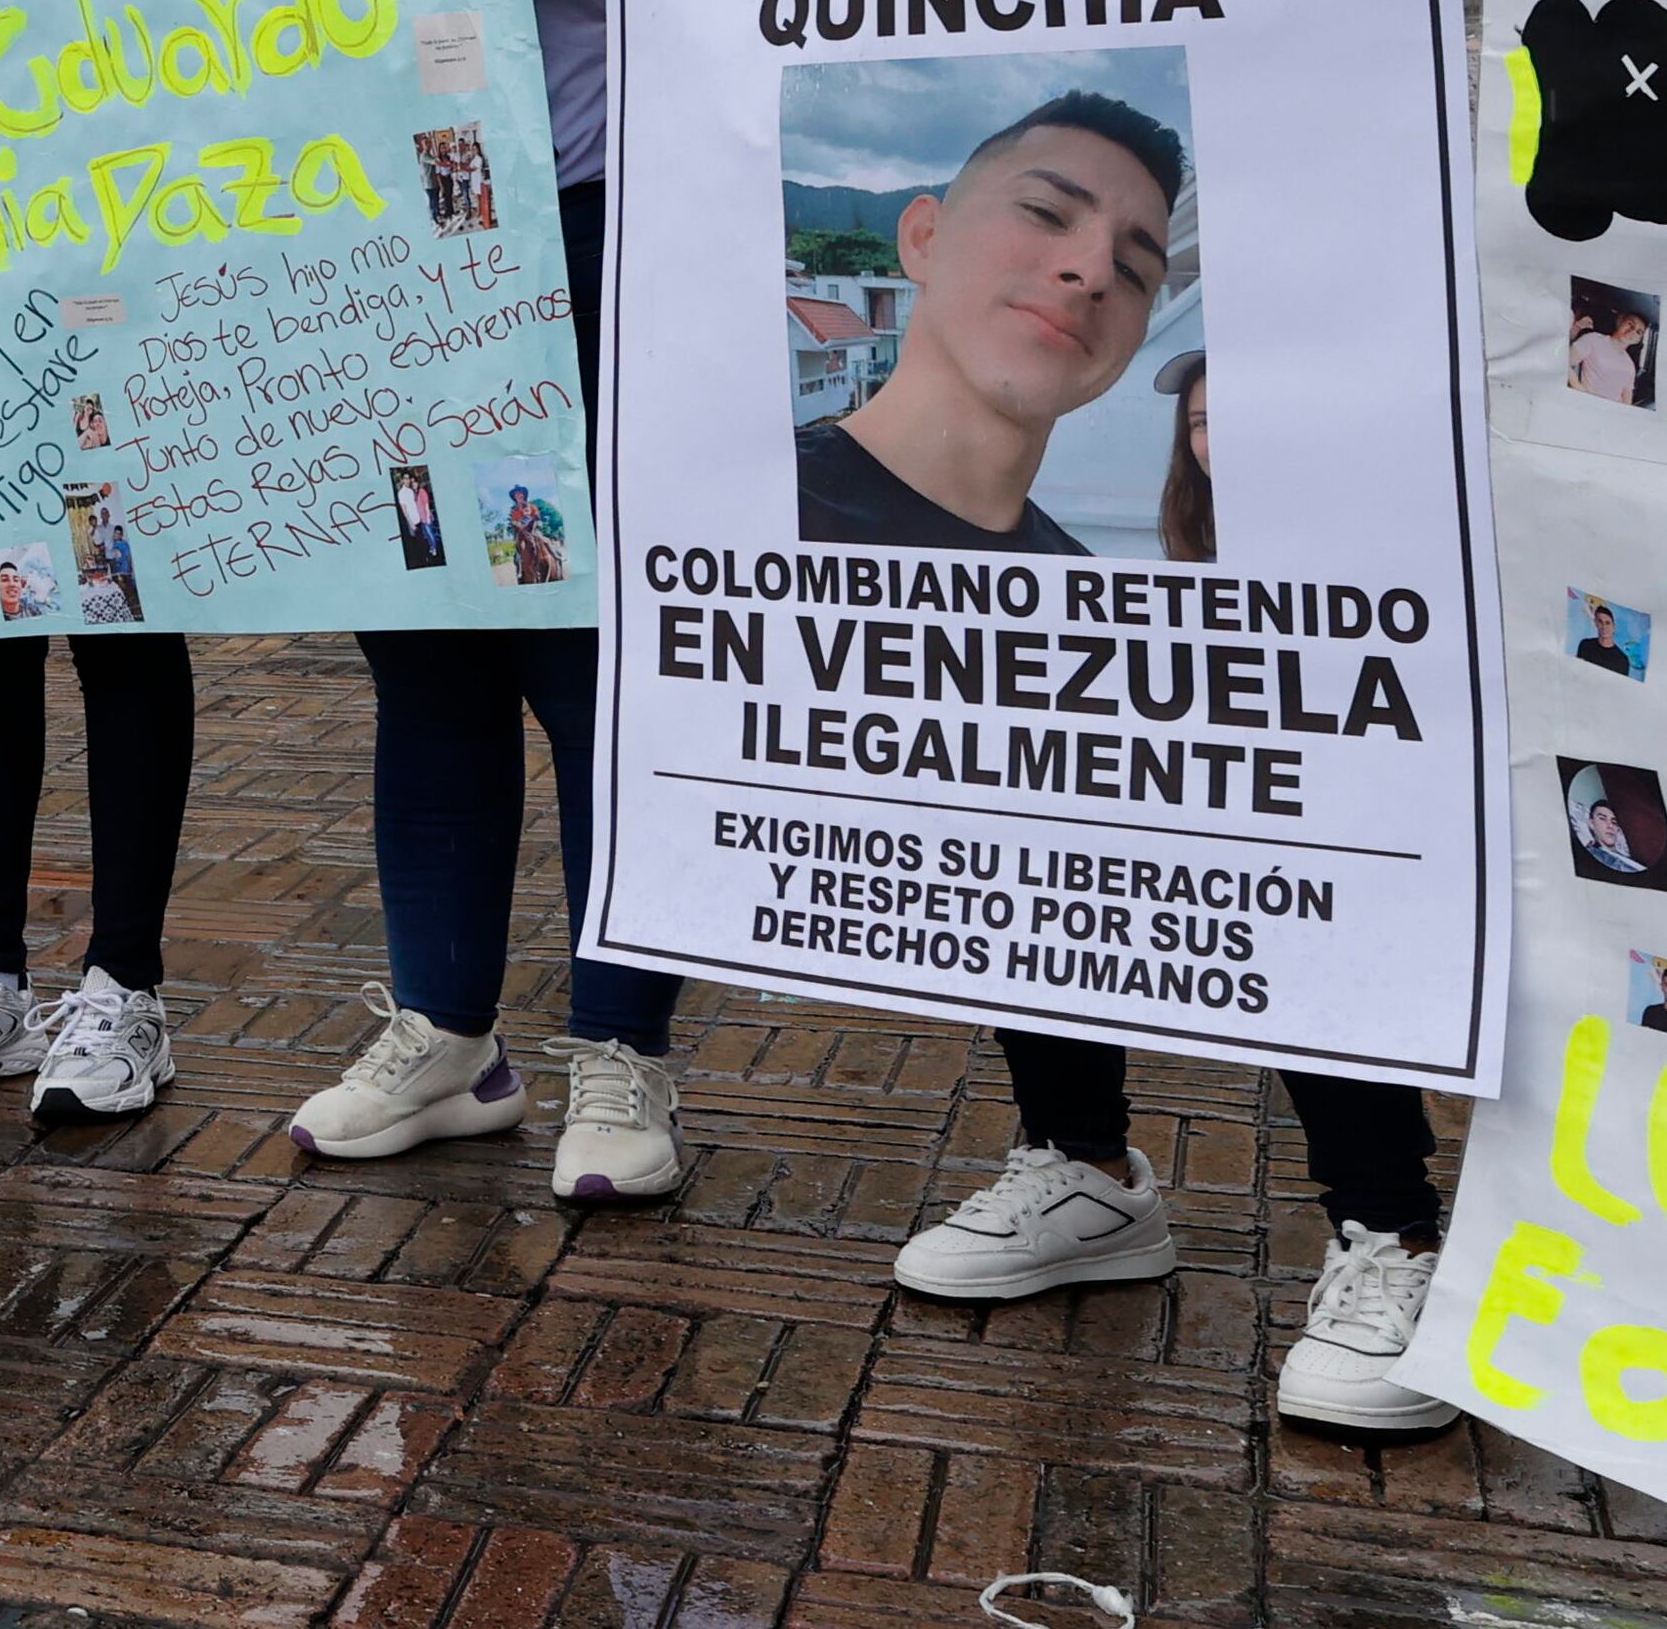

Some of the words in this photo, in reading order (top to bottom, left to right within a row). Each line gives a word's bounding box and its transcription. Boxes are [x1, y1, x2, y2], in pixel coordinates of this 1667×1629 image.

[14, 289, 59, 343] en
[212, 319, 258, 357] te
[460, 237, 521, 291] te
[237, 348, 368, 413] Pronto
[389, 288, 573, 369] estaremos
[235, 414, 283, 456] de
[645, 545, 1041, 619] COLOMBIANO
[1066, 569, 1430, 644] RETENIDO
[658, 604, 765, 685] EN
[795, 617, 1423, 742] VENEZUELA
[740, 701, 1303, 817] ILEGALMENTE
[714, 811, 924, 873] EXIGIMOS
[938, 838, 1001, 886] SU
[1018, 847, 1334, 924] LIBERACIÓN
[769, 862, 798, 902] Y
[809, 868, 1016, 930] RESPETO
[1031, 898, 1131, 948] POR
[1151, 911, 1255, 963] SUS
[752, 905, 991, 976] DERECHOS
[1005, 943, 1269, 1014] HUMANOS
